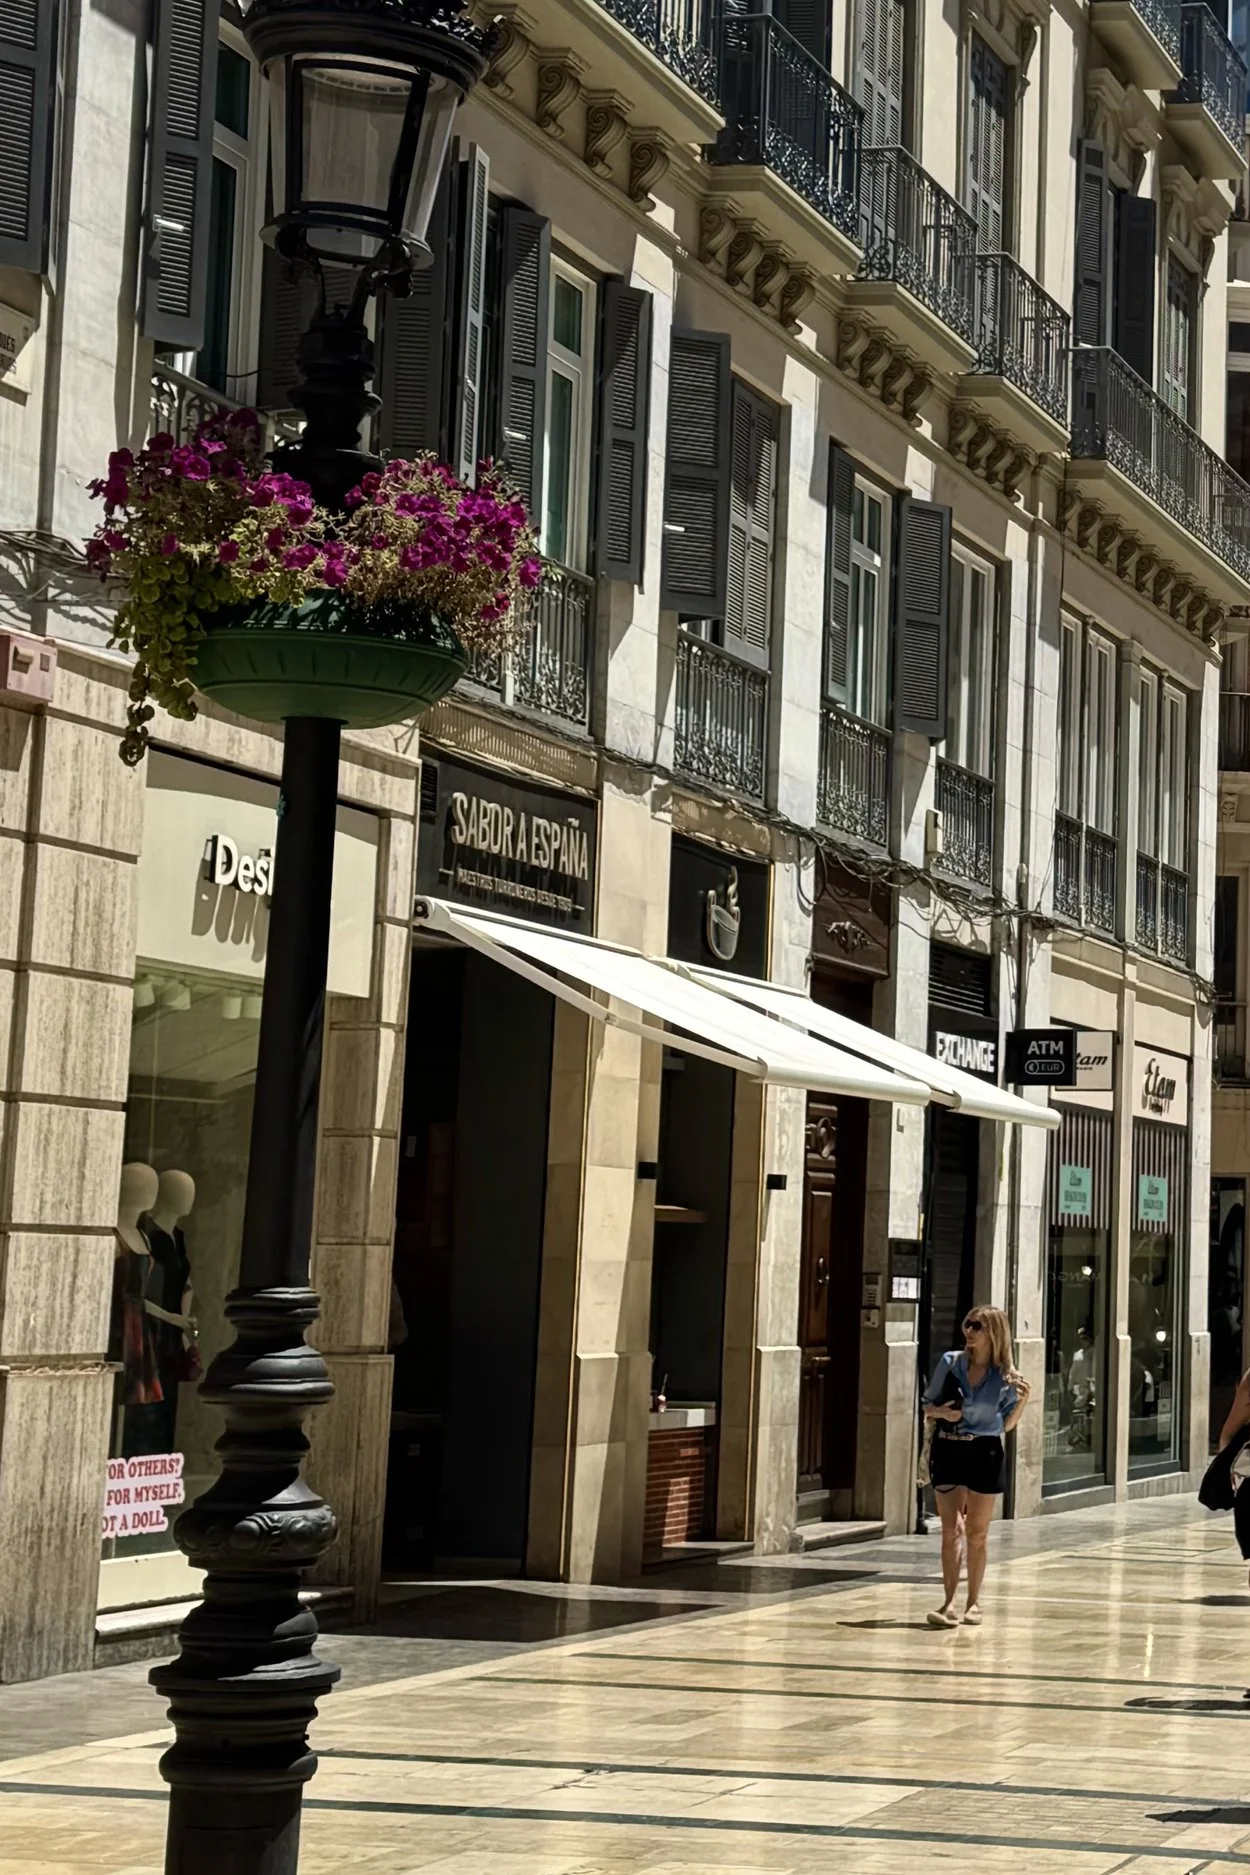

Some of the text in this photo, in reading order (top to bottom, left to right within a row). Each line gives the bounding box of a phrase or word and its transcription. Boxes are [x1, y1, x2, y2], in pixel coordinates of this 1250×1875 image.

[452, 792, 588, 881] SABOR A ESPAÑA
[935, 1031, 995, 1073] EXCHANGE
[1027, 1040, 1064, 1055] ATM
[1041, 1063, 1060, 1072] EUR
[1076, 1052, 1108, 1066] tam
[107, 1458, 180, 1480] OR OTHERS?
[106, 1482, 182, 1506] FOR MYSELF.
[119, 1513, 128, 1531] A
